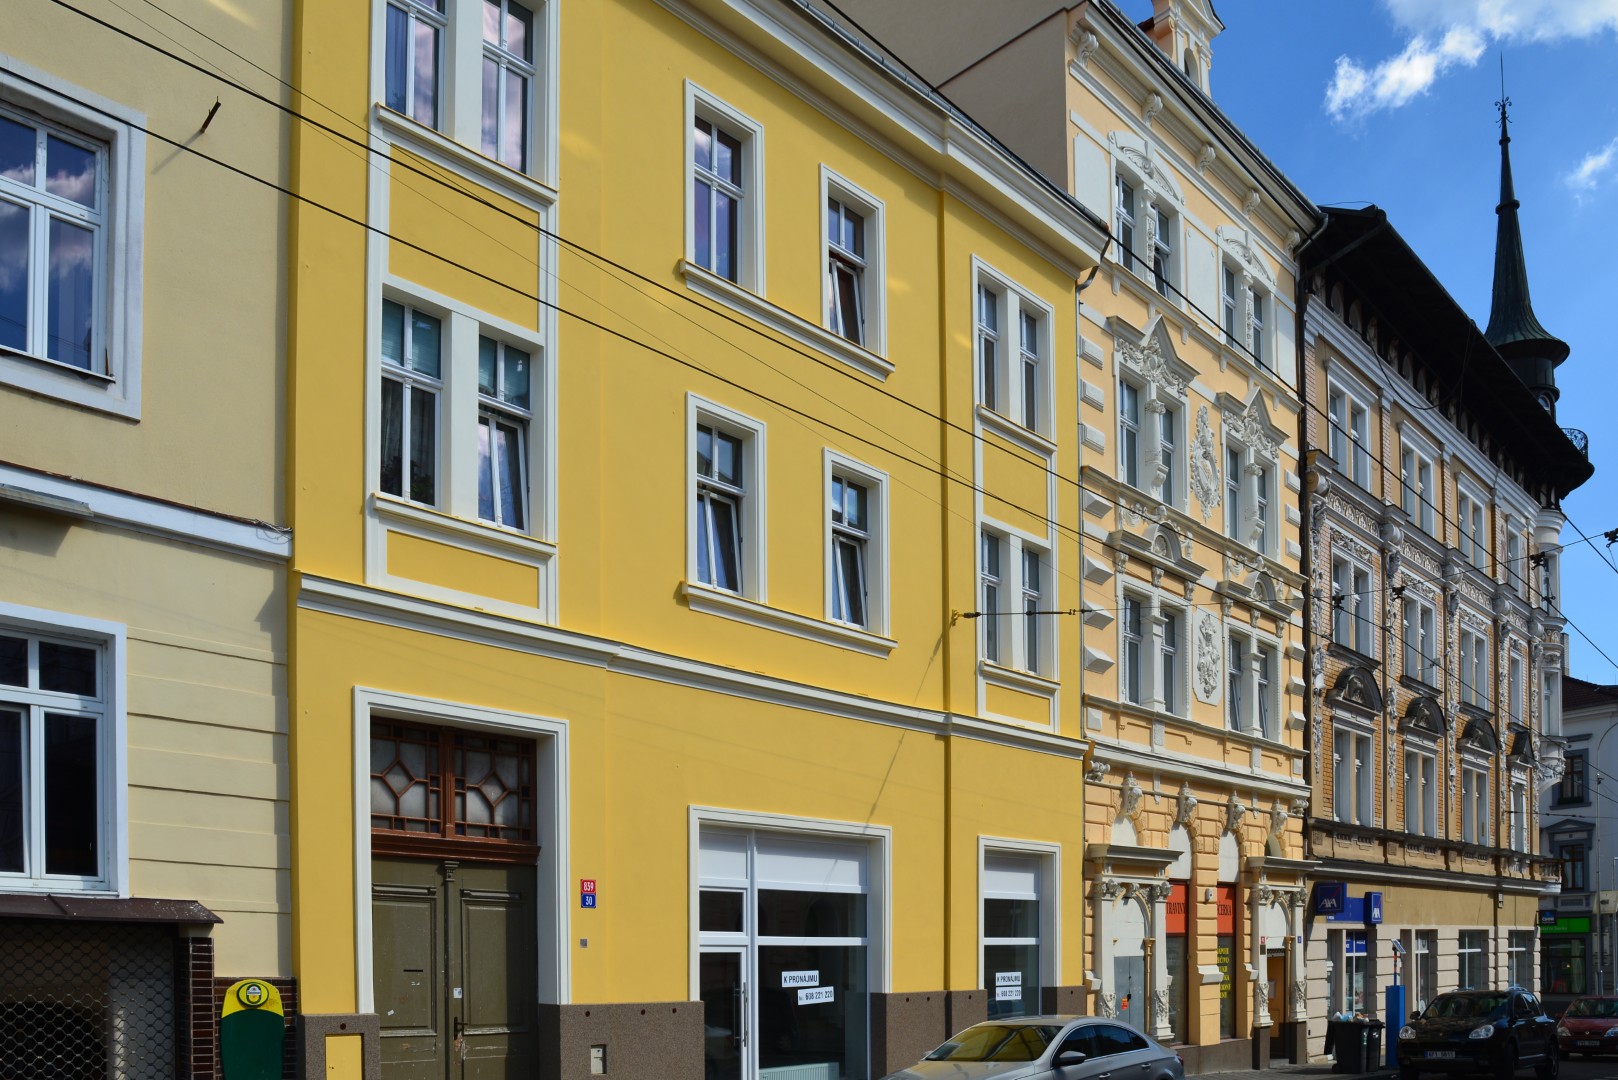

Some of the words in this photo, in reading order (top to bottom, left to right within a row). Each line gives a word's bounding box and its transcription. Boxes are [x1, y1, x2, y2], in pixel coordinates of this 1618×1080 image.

[586, 896, 593, 905] 30
[1319, 898, 1337, 908] AXA
[784, 976, 788, 984] K
[789, 974, 818, 984] PRONÁJMU
